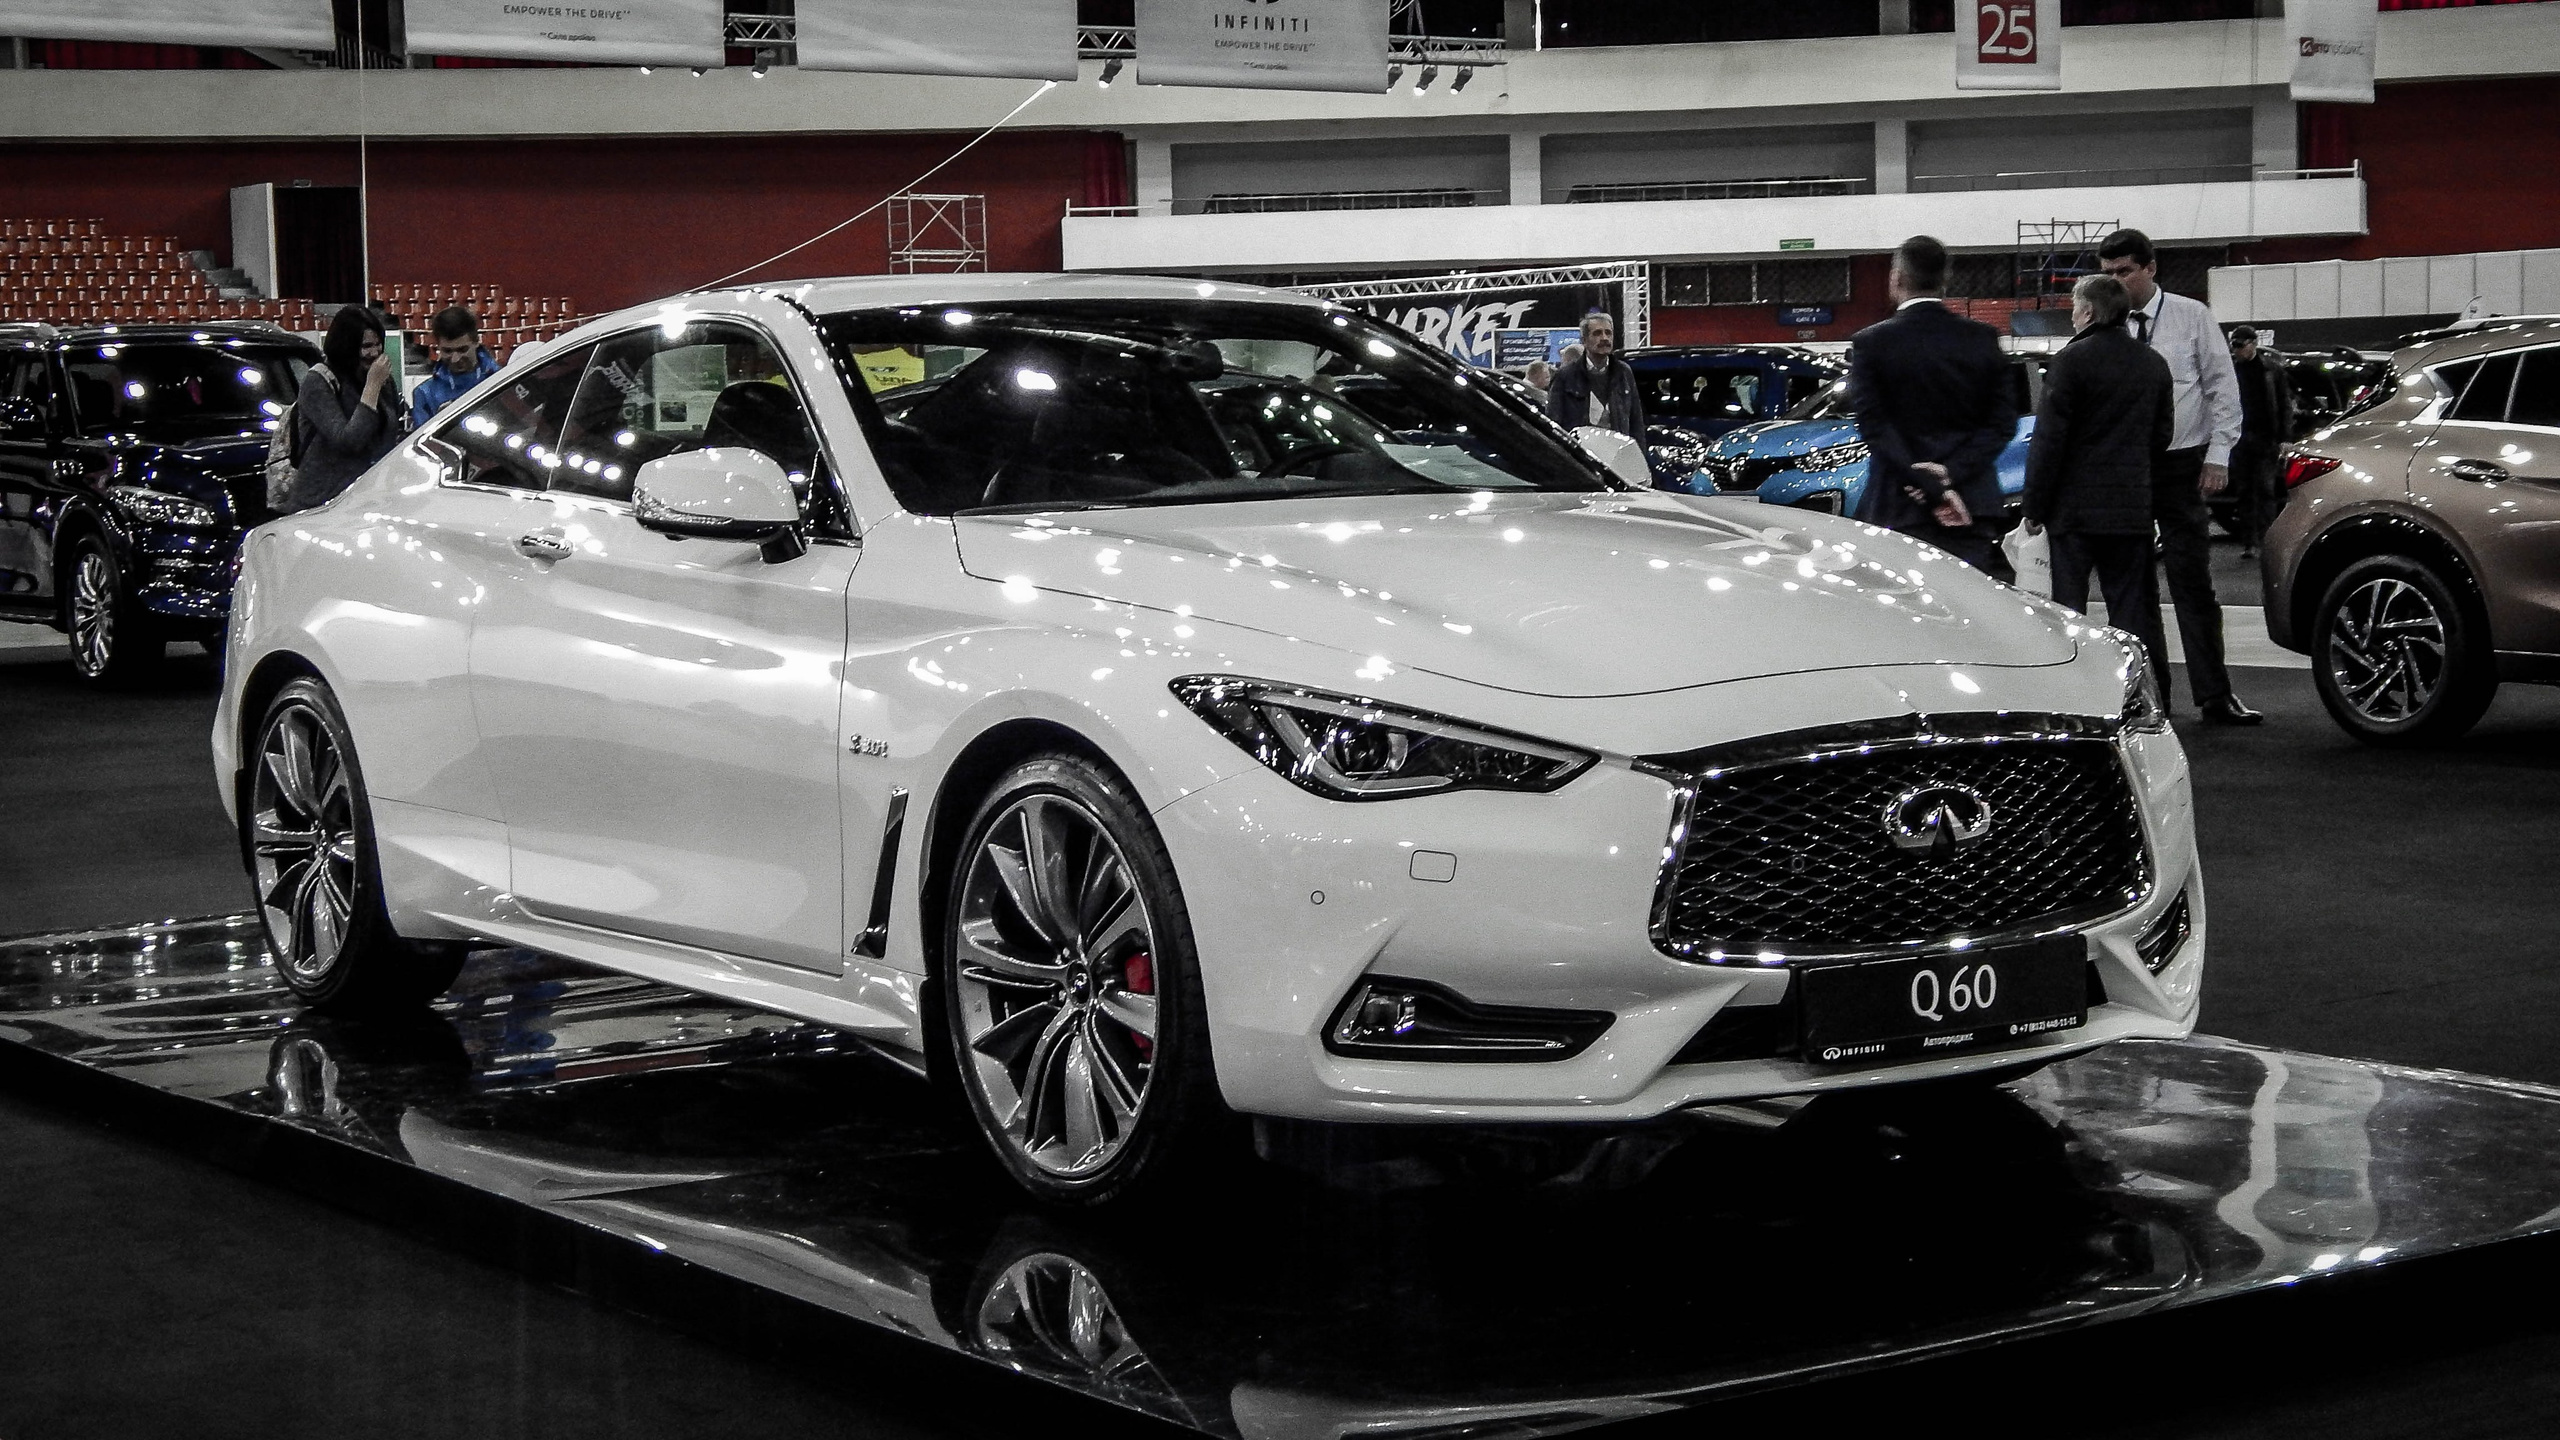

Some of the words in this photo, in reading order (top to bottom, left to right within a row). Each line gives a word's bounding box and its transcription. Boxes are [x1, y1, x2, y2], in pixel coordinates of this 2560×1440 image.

[503, 4, 562, 17] EMPOWER
[565, 7, 587, 18] THE
[1214, 13, 1308, 33] INFINITI
[1981, 4, 2034, 57] 25
[1214, 39, 1261, 50] EMPOWER
[1263, 41, 1281, 51] THE
[1368, 299, 1540, 363] ARKET
[1842, 1044, 1885, 1056] INFINITI
